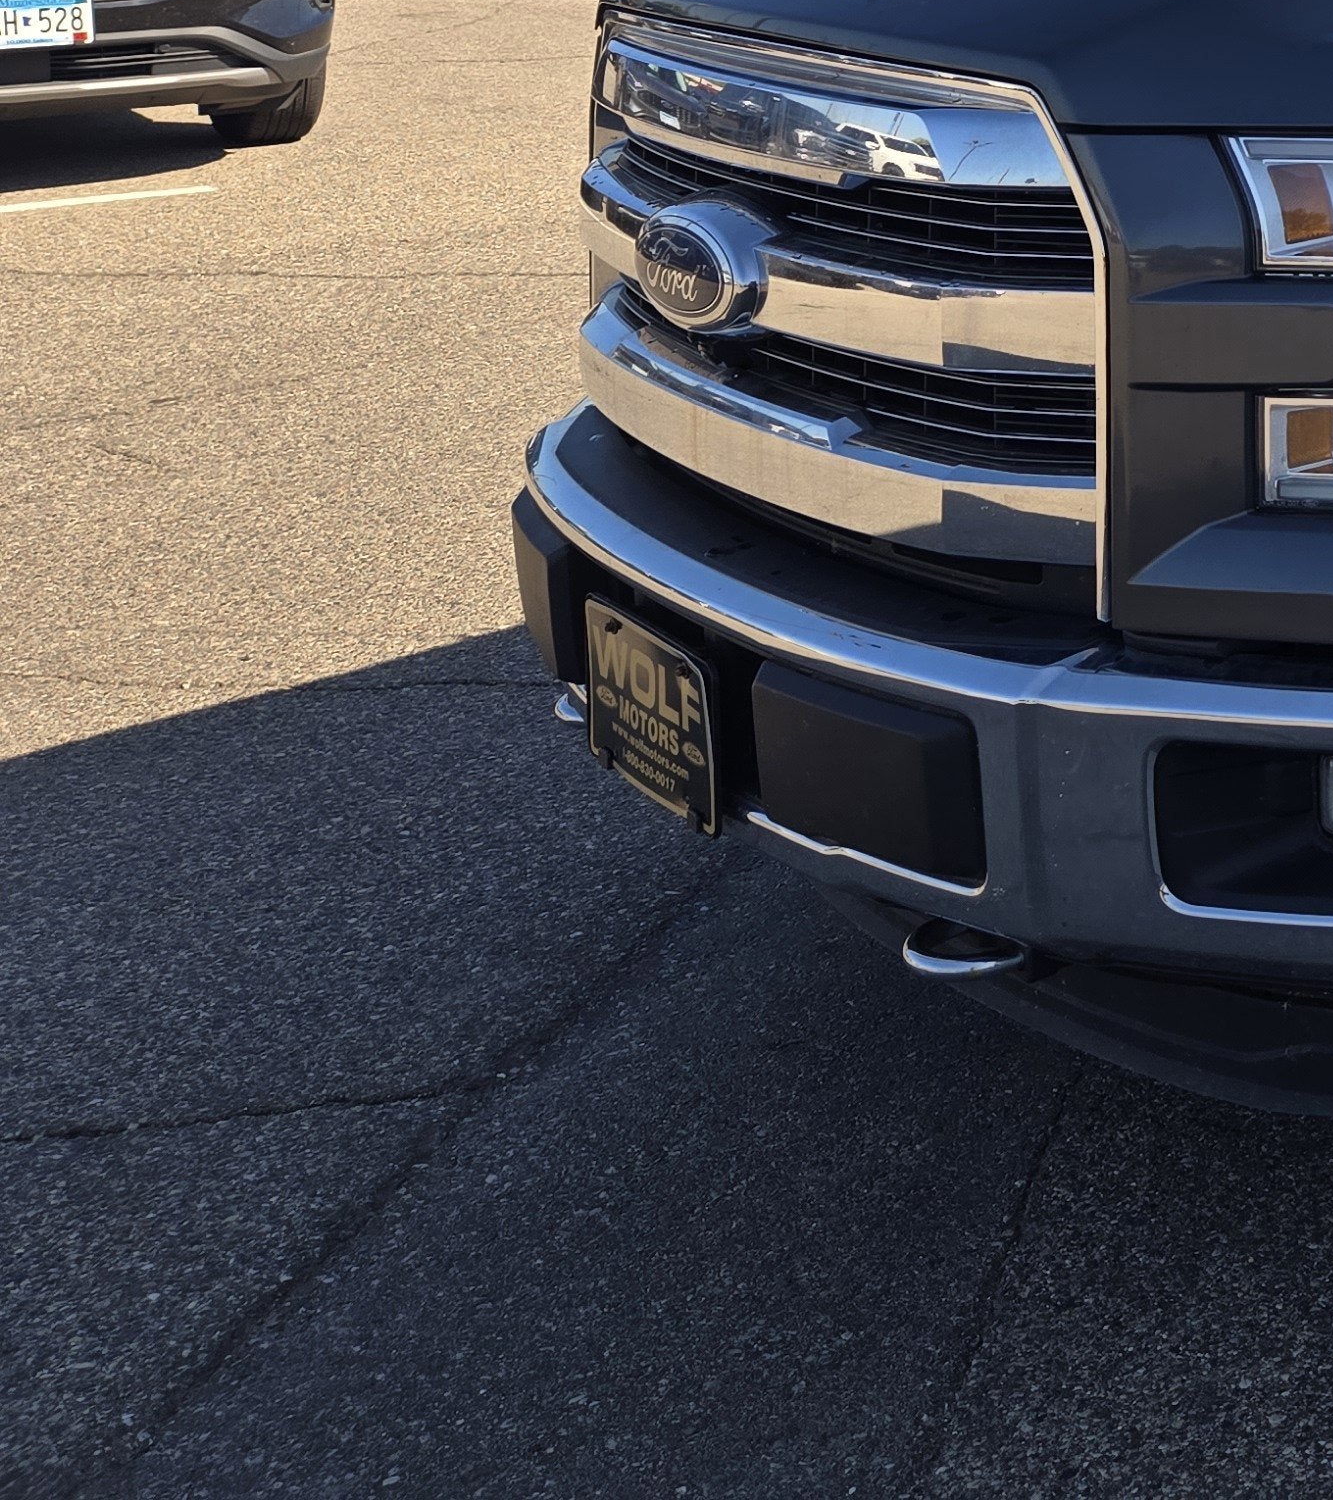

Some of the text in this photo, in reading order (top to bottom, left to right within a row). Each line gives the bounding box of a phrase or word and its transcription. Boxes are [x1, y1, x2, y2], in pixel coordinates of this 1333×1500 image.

[0, 6, 83, 36] H 528
[646, 236, 702, 301] Ford
[592, 625, 701, 733] WOLF
[620, 695, 680, 756] MOTORS
